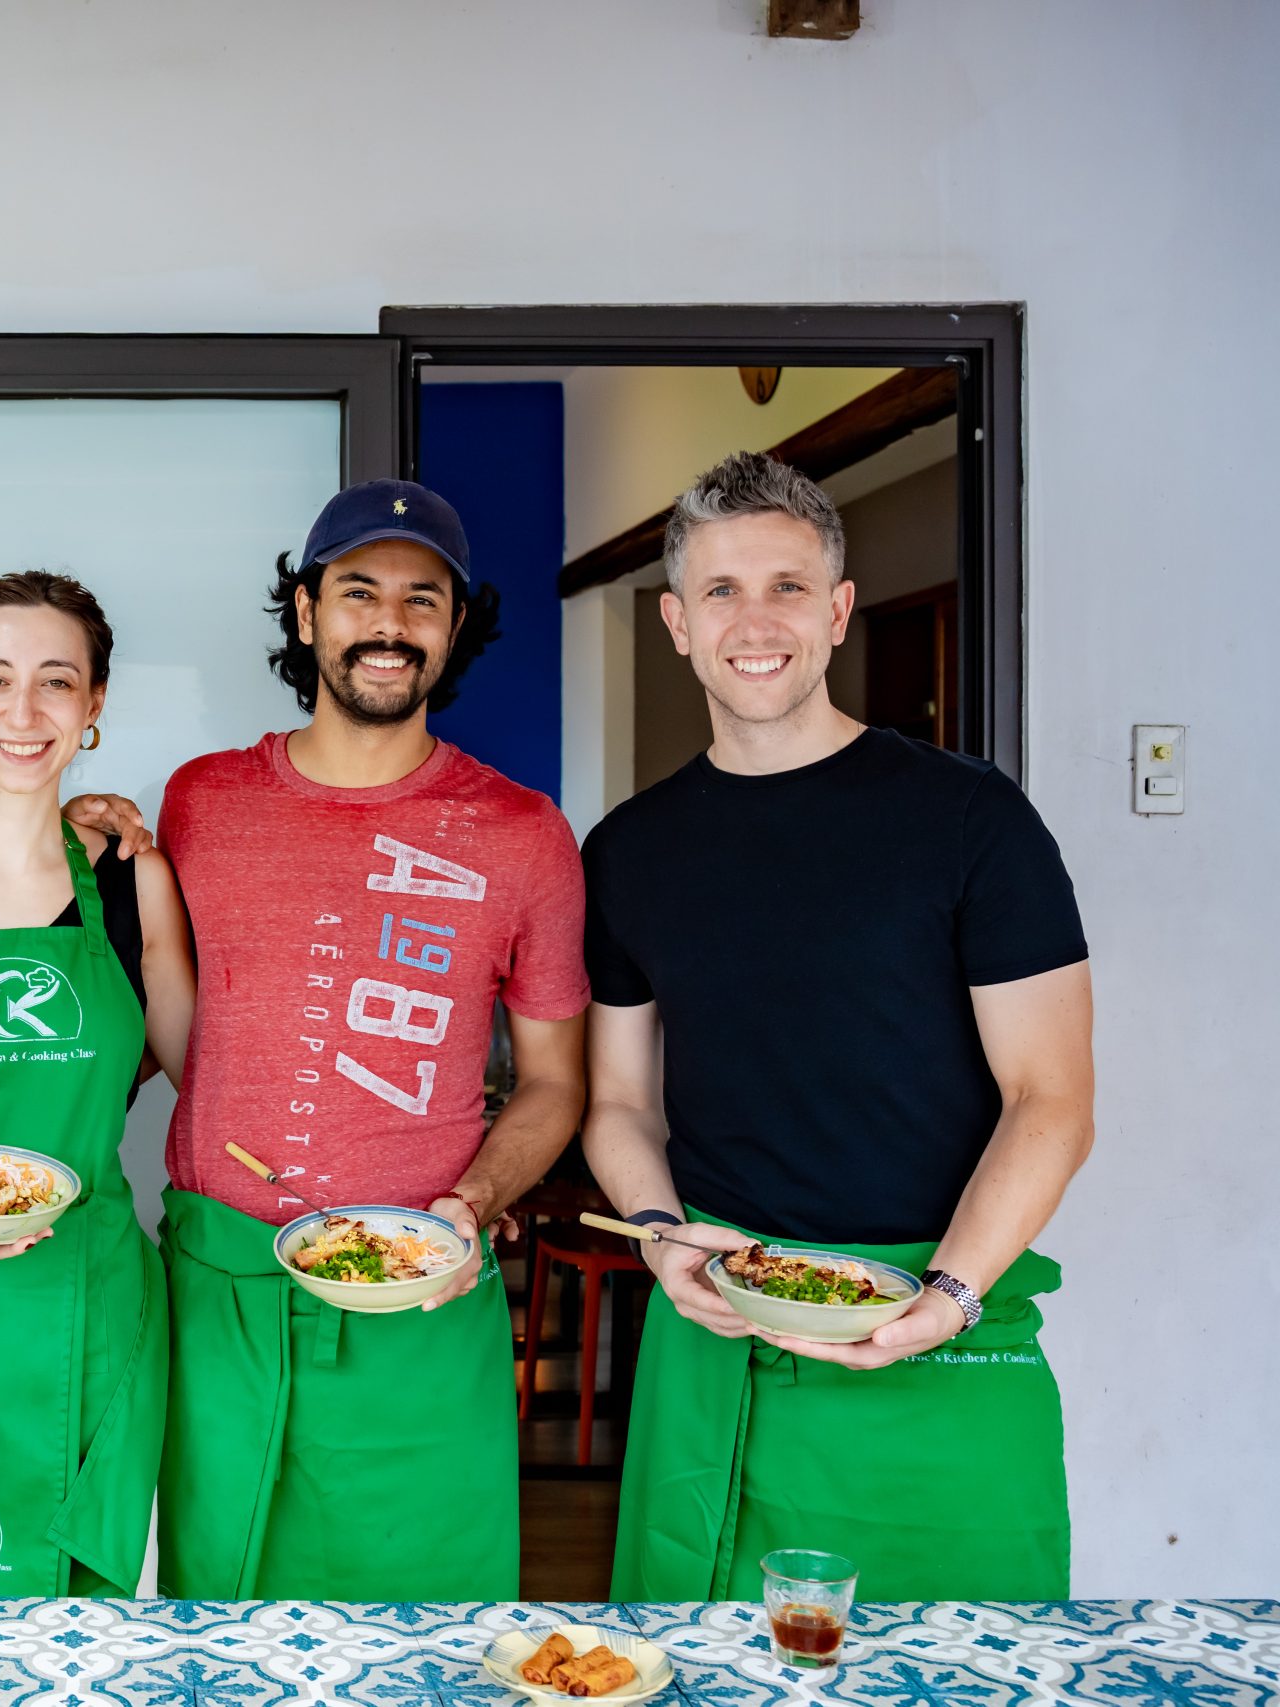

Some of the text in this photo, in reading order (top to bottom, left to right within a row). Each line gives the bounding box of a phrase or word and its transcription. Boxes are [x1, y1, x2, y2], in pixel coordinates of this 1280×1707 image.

[366, 833, 488, 902] A
[9, 1052, 19, 1062] &
[22, 1051, 68, 1062] Cooking
[943, 1352, 988, 1364] Kitchen
[990, 1352, 1000, 1363] &
[1003, 1352, 1037, 1364] Cooking
